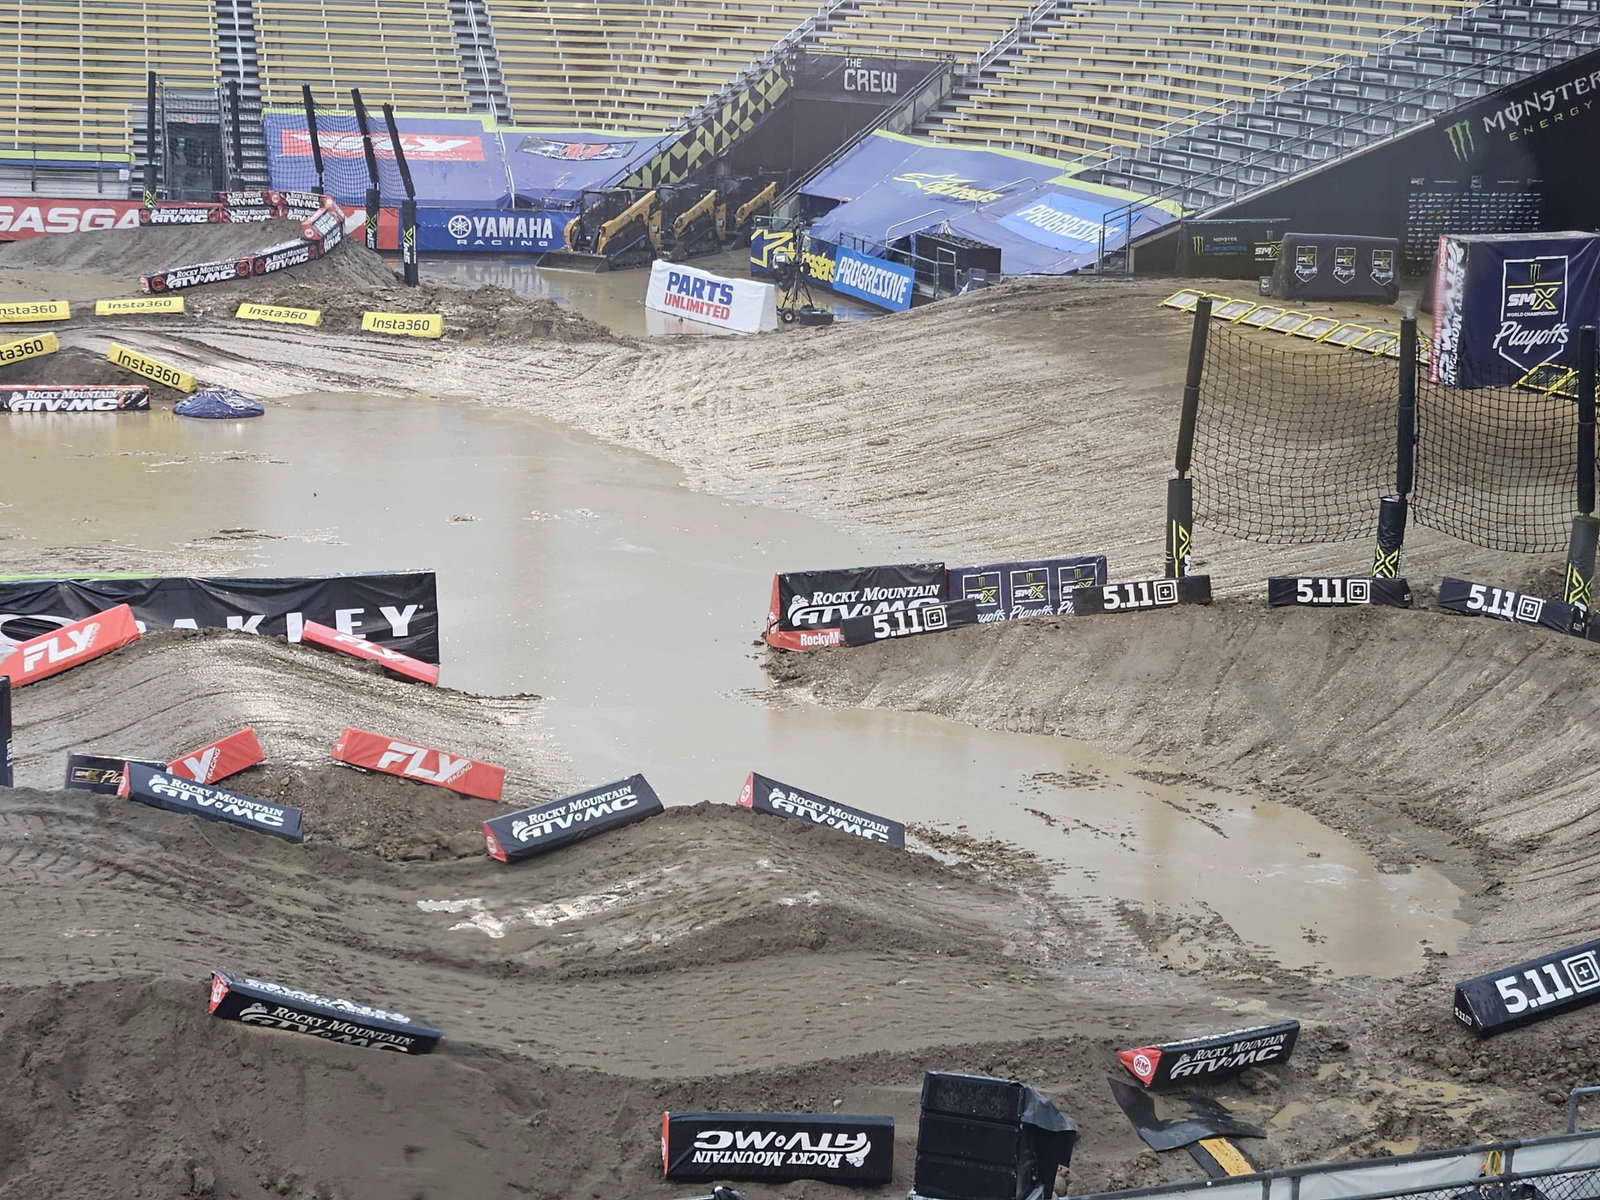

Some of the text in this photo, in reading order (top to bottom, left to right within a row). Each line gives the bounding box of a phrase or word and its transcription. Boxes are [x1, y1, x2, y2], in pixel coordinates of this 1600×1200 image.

[845, 58, 862, 68] THE
[844, 69, 897, 94] CREW
[1509, 101, 1593, 142] ENERGY
[473, 216, 553, 239] YAMAHA
[666, 271, 734, 306] PARTS
[835, 256, 909, 304] PROGRESSIVE
[108, 299, 172, 310] Insta360
[664, 292, 731, 321] UNLIMITED
[1506, 287, 1559, 310] SMX
[248, 306, 308, 321] Insta360
[372, 317, 430, 331] Insta360
[1492, 321, 1570, 354] Playoffs
[117, 350, 181, 386] Insta360
[25, 389, 118, 399] ROCKY MOUNTAIN
[812, 584, 941, 606] ROCKY MOUNTAIN
[1014, 585, 1045, 599] SMX
[1103, 582, 1153, 610] 5.11
[1297, 579, 1345, 603] 5.11
[1466, 584, 1516, 617] 5.11
[872, 609, 924, 640] 5.11
[23, 622, 99, 673] FLY
[207, 748, 220, 780] RACING
[376, 741, 472, 783] FLY
[447, 763, 474, 785] RACING
[170, 778, 284, 817] ROCKY MOUNTAIN
[527, 785, 632, 825] ROCKY MOUNTAIN
[788, 791, 890, 834] ROCKY MOUNTAIN
[1494, 963, 1574, 1014] 5.11
[271, 1006, 416, 1046] ROCKY MOUNTAIN
[1192, 1033, 1288, 1062] ROCKY MOUNTAIN
[691, 1150, 843, 1169] ROCKY MOUNTAIN
